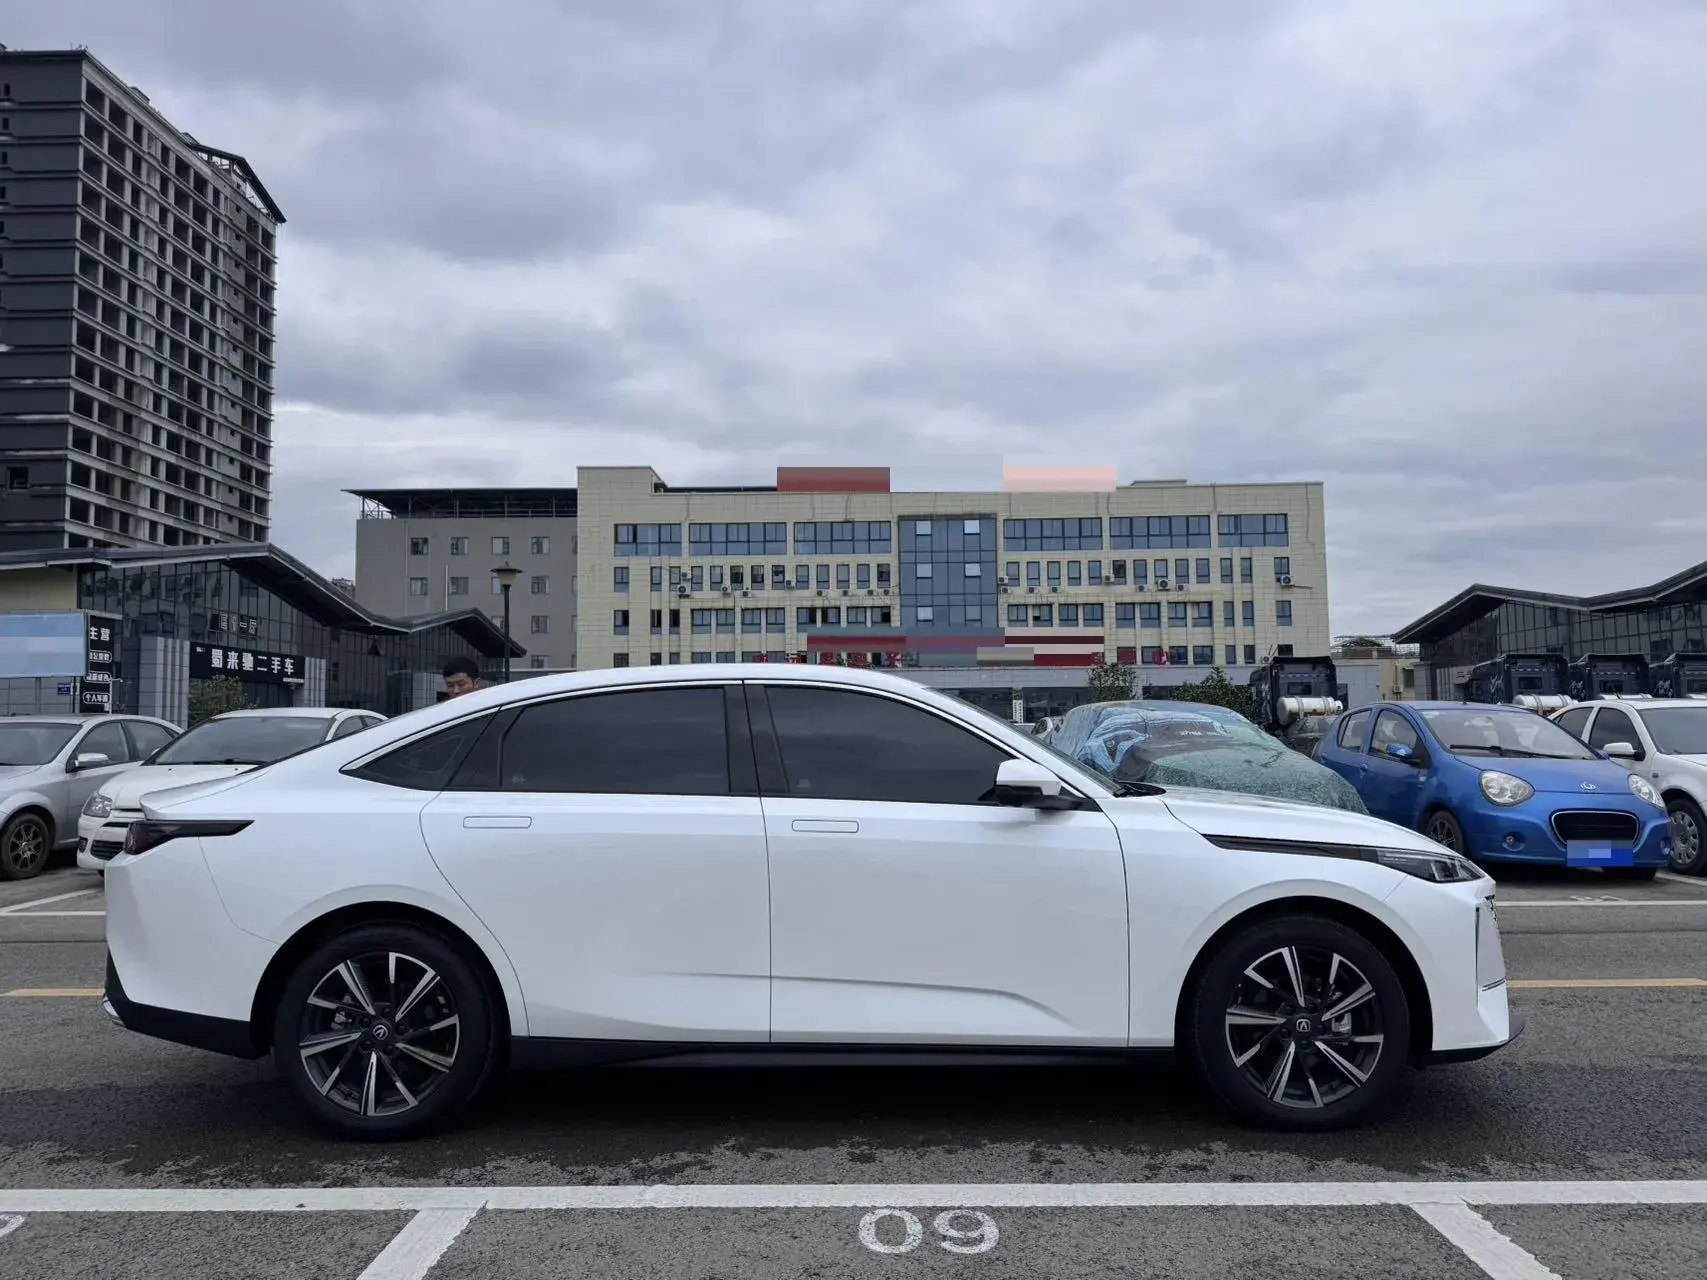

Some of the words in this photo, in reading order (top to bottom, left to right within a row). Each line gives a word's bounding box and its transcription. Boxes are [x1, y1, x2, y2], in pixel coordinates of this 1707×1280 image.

[90, 627, 110, 641] 主营
[211, 648, 294, 675] 蜀来驰二手车
